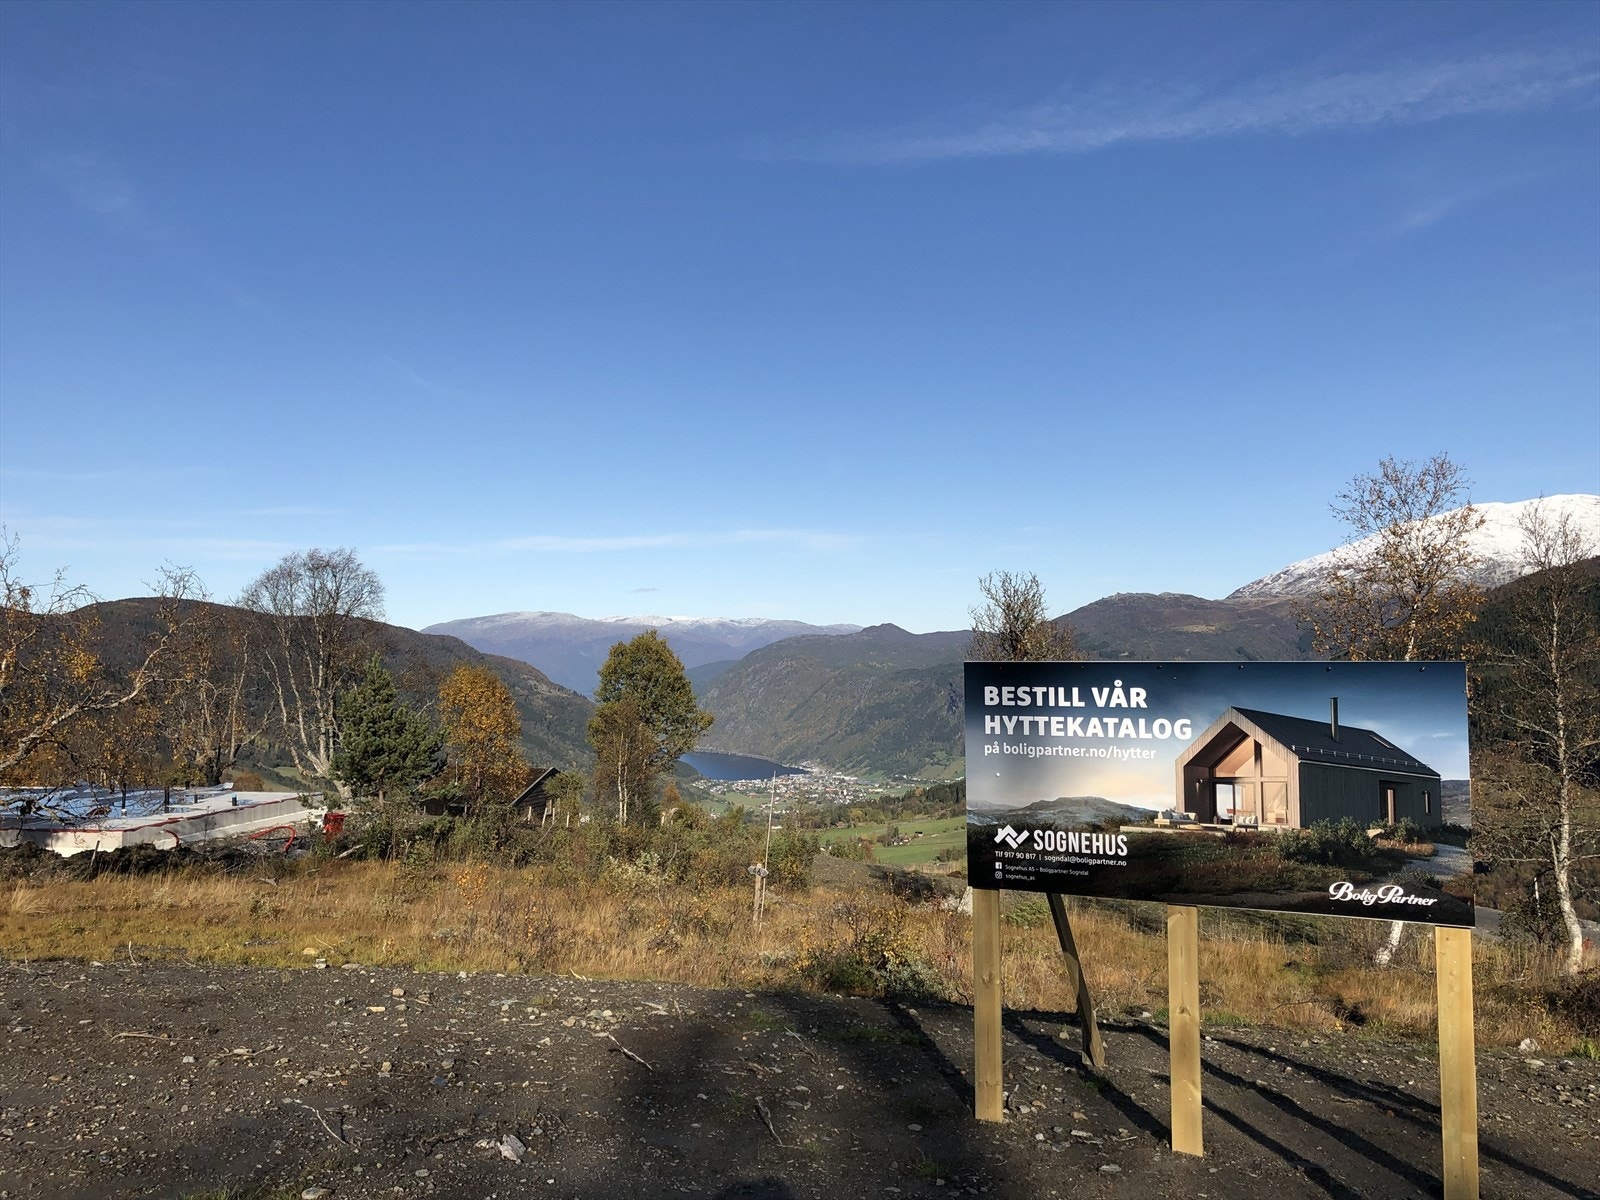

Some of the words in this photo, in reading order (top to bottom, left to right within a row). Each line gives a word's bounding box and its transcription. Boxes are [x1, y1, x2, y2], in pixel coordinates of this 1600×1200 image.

[984, 686, 1085, 708] BESTILL
[1091, 679, 1148, 709] VÅR
[984, 715, 1192, 740] HYTTEKATALOG
[984, 741, 1000, 756] på
[1003, 743, 1156, 759] boligpartner.no/hytter
[1033, 829, 1128, 856] SOGNEHUS
[1004, 851, 1015, 859] 917
[1015, 852, 1025, 860] 90
[1044, 855, 1127, 867] sogndal@boligpartner.no
[1005, 864, 1028, 872] Sognehus
